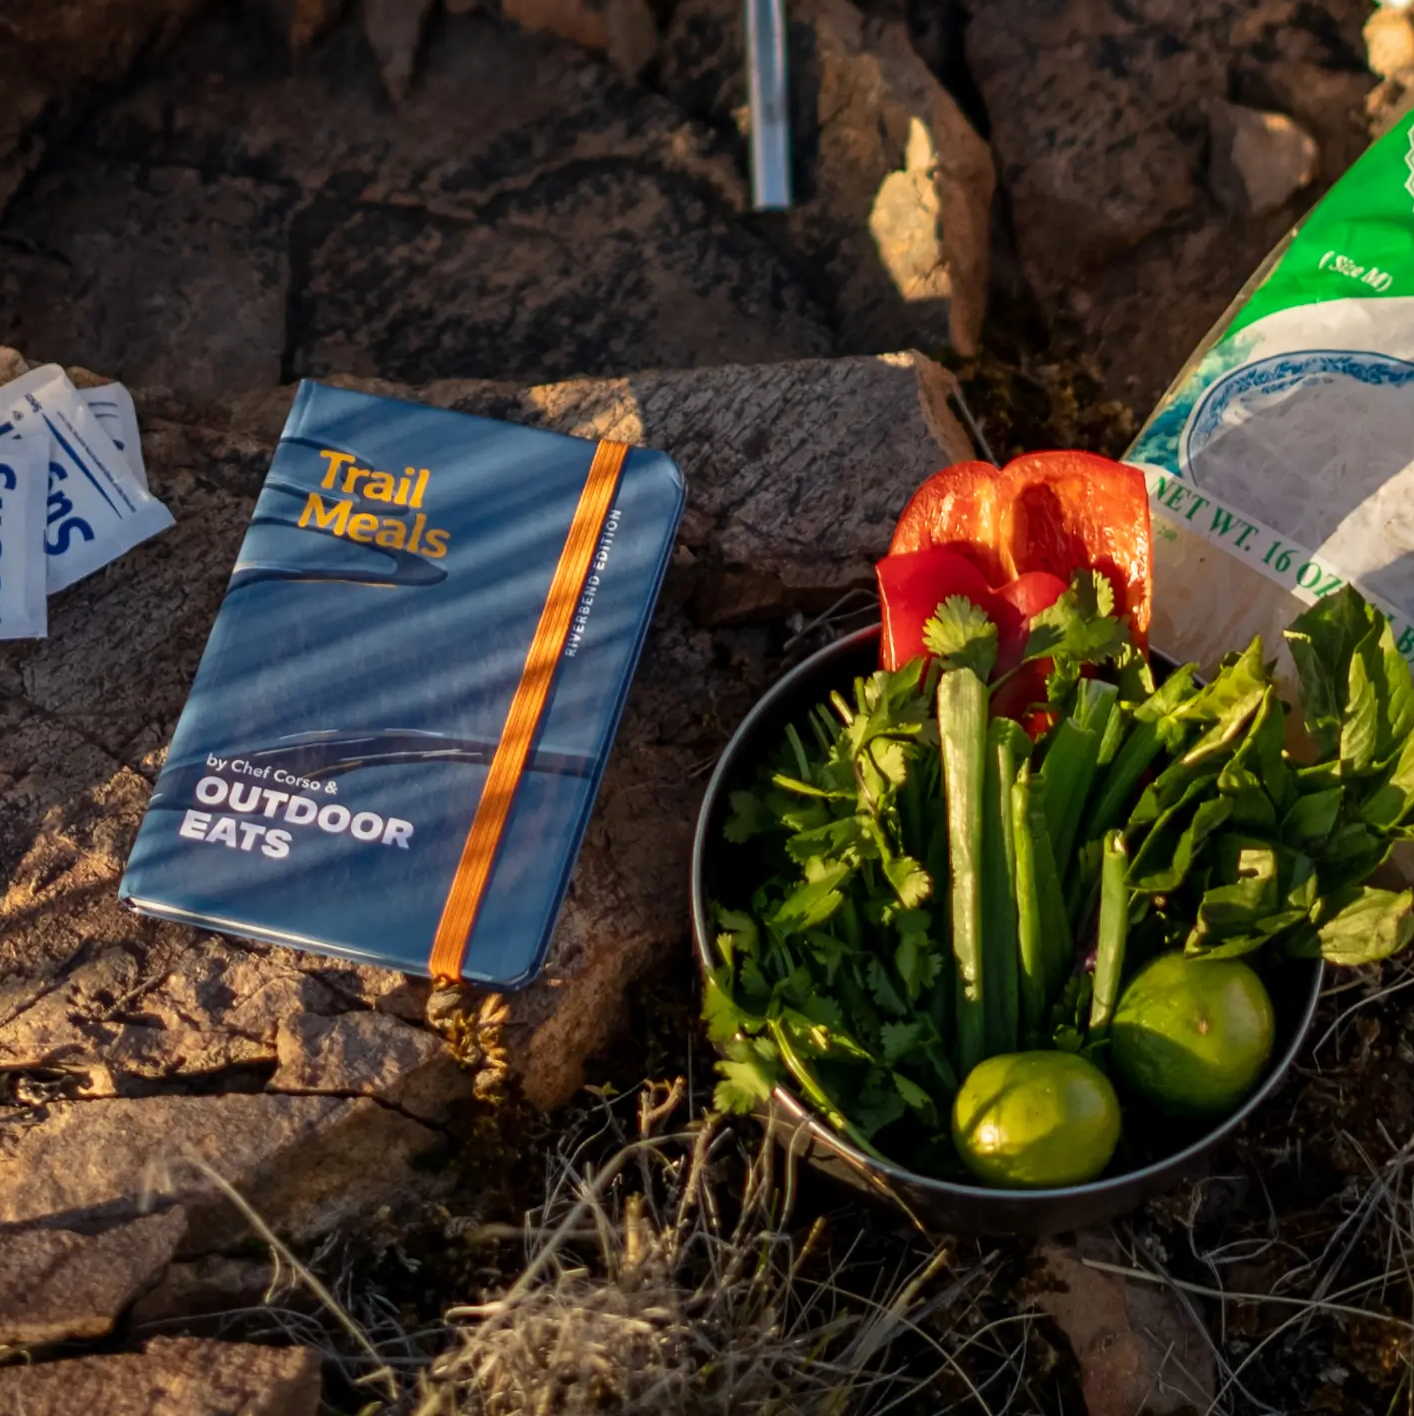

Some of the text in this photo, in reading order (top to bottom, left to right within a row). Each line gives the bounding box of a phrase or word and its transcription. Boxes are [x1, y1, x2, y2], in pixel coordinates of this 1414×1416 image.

[319, 450, 431, 508] Trail
[297, 493, 451, 559] Meals
[1153, 475, 1211, 522] NET
[1208, 507, 1260, 552] WT.
[1261, 540, 1300, 574] 16
[565, 509, 623, 657] RIVERBEND EDITION
[206, 752, 339, 796] by Chef Corso &
[179, 810, 293, 859] EATS
[193, 776, 415, 849] OUTDOOR
